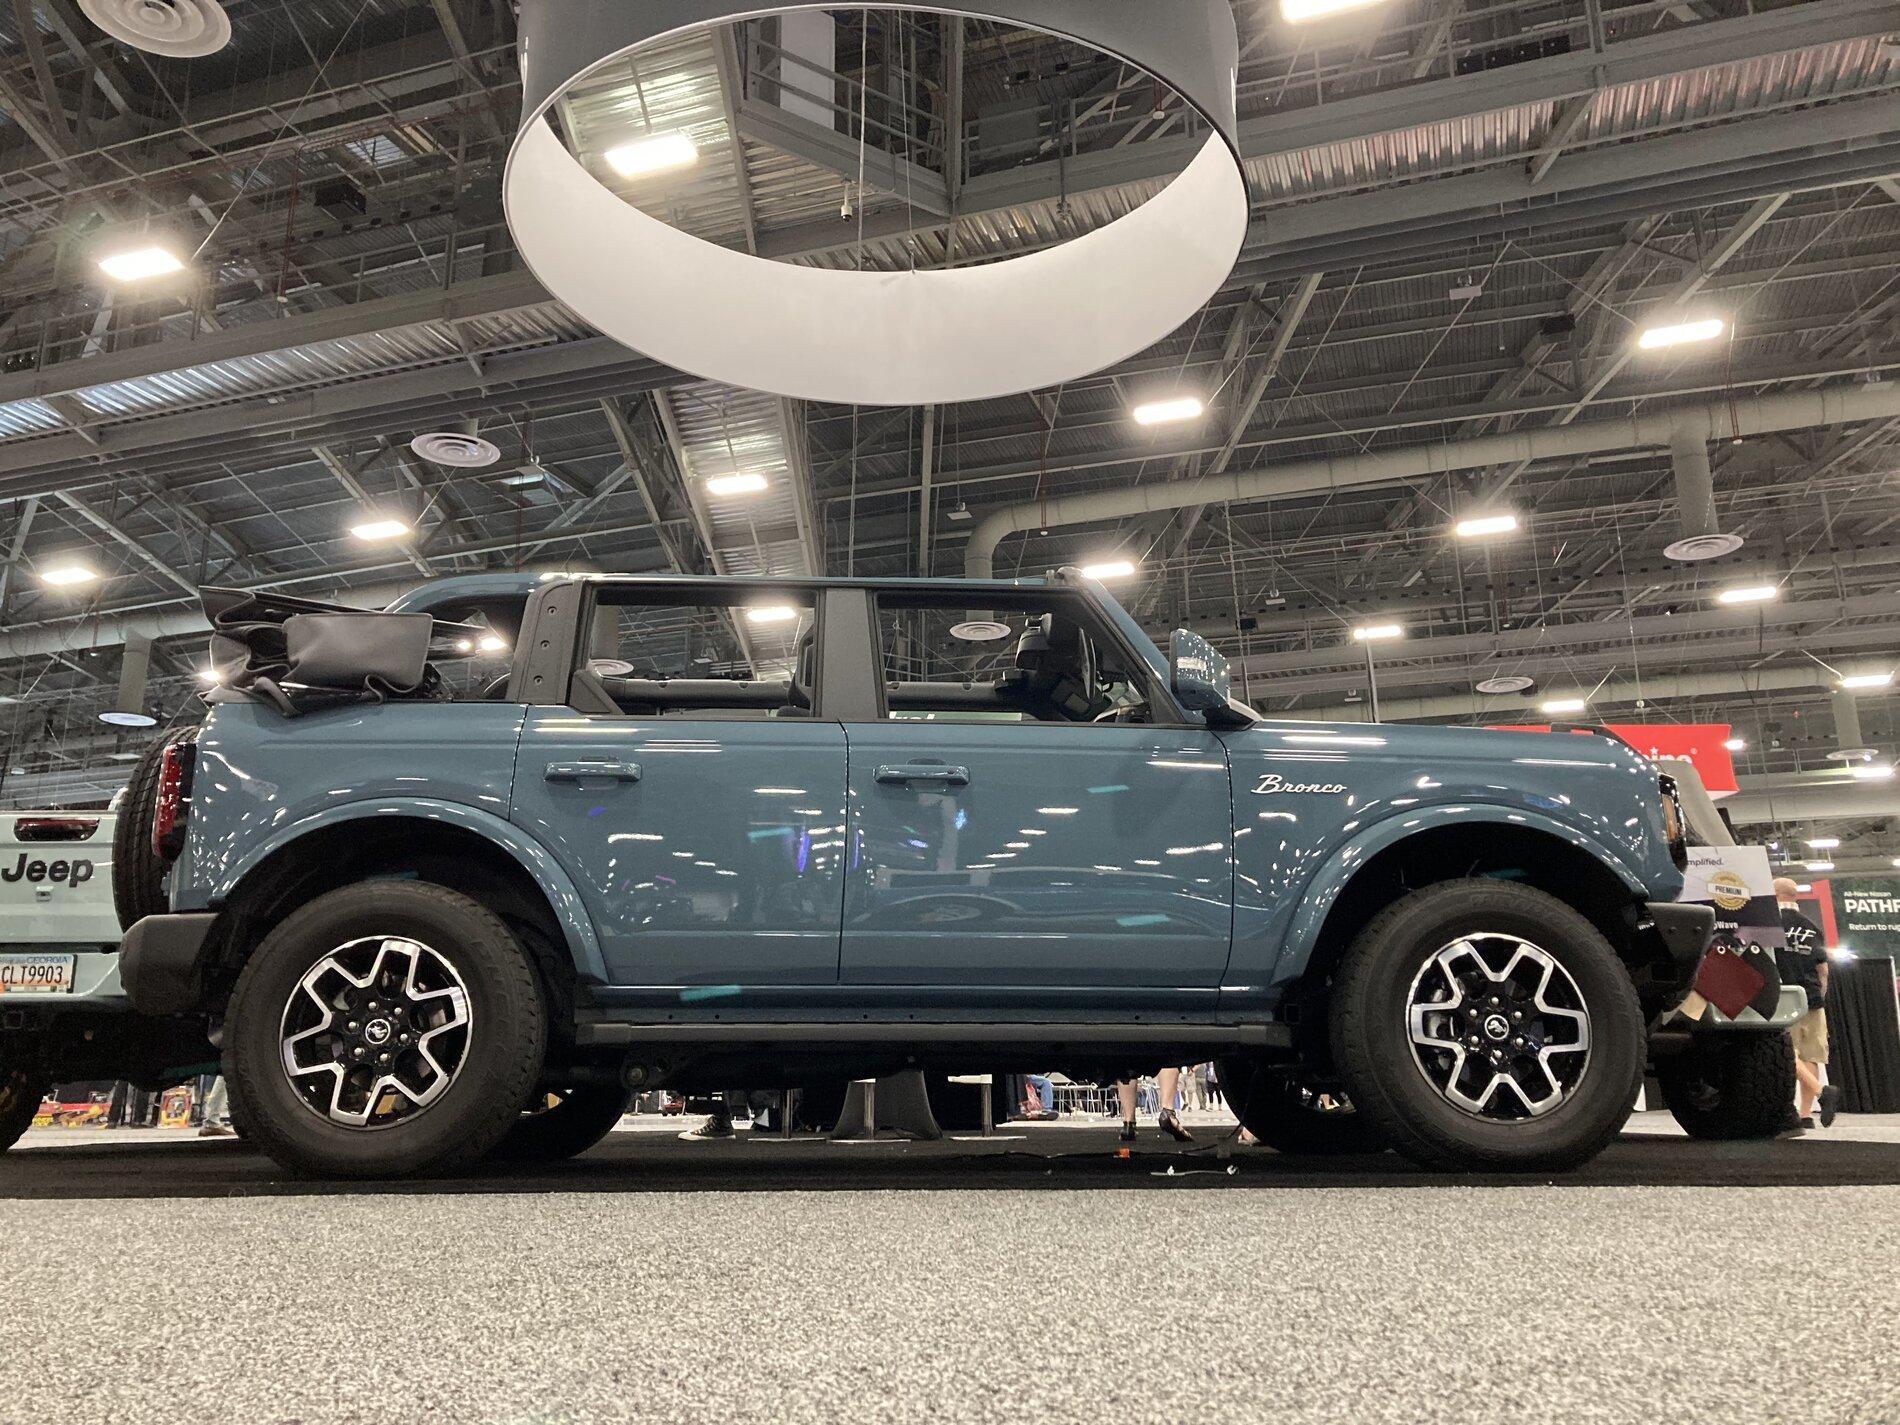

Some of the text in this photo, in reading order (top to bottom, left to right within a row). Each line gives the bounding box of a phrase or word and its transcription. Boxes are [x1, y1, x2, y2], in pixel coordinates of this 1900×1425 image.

[1251, 774, 1347, 794] Bronco
[1, 853, 94, 888] Jeep
[1715, 885, 1742, 896] PREMIUM
[1849, 923, 1877, 931] Return
[26, 956, 68, 964] GEORGIA
[1, 965, 63, 985] CLT9903
